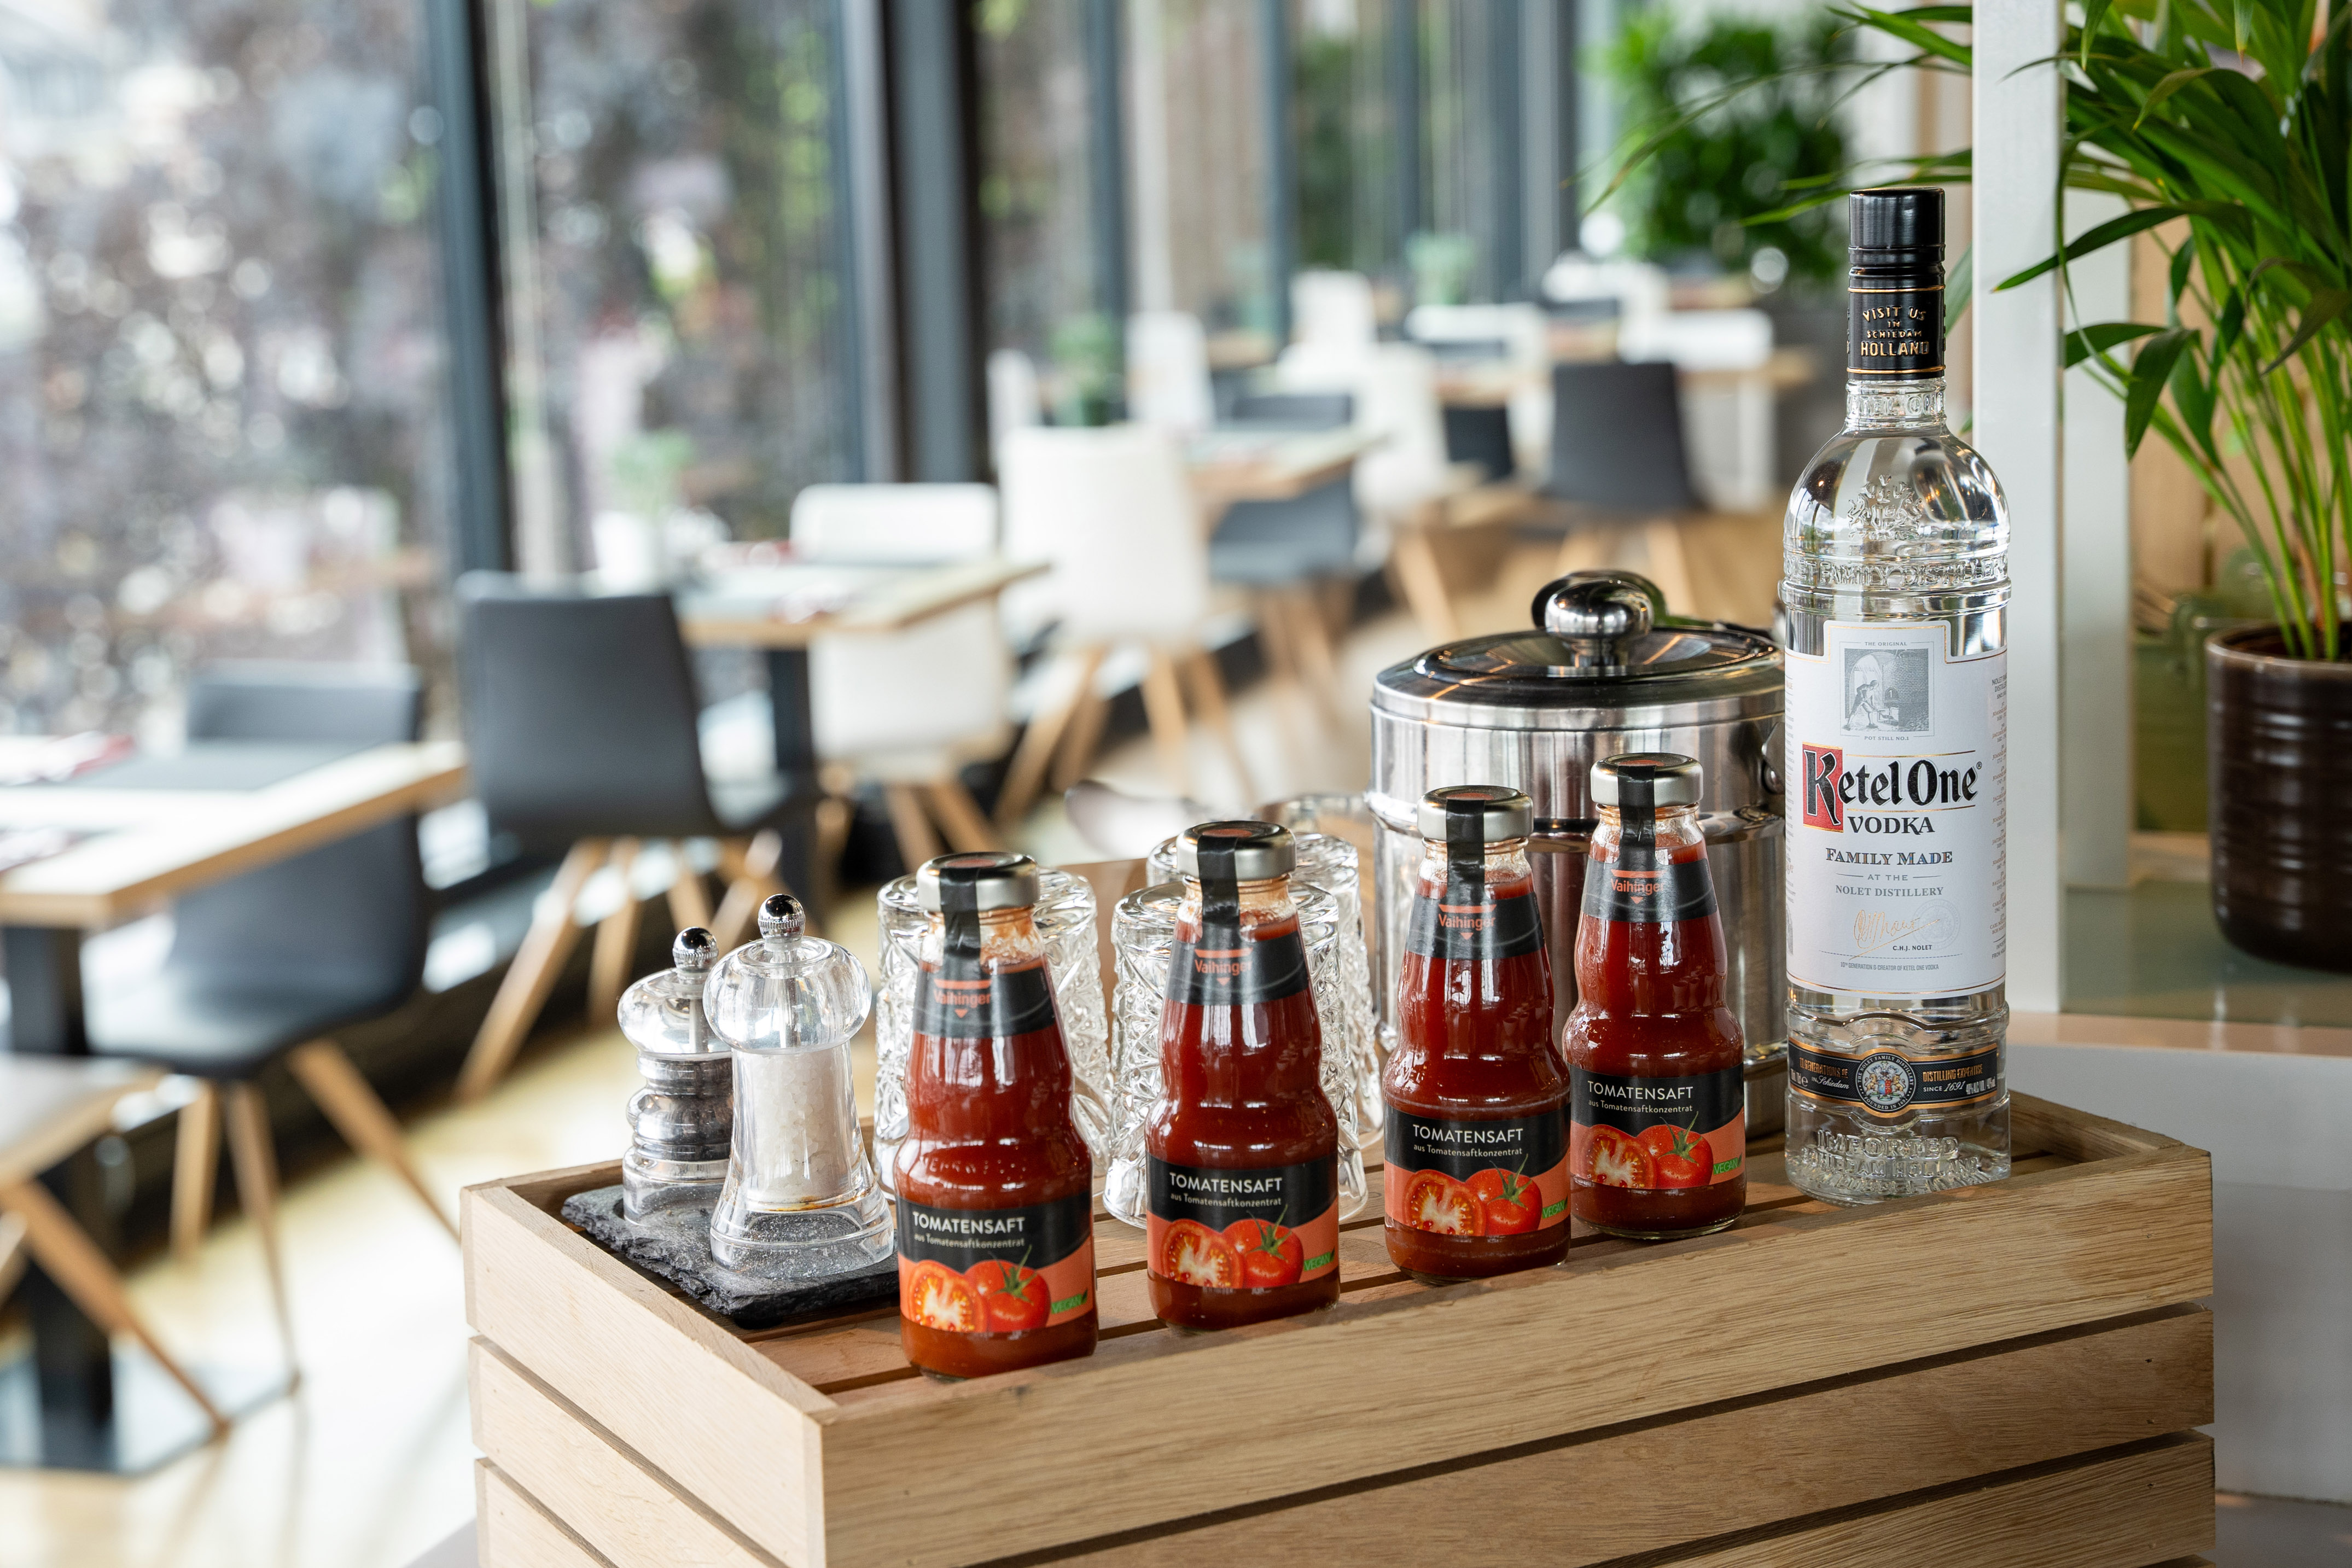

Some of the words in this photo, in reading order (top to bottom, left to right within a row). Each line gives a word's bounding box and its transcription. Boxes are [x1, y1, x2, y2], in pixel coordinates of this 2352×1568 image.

[1862, 306, 1902, 322] VISIT
[1909, 306, 1926, 320] US
[1867, 329, 1922, 338] SCHIEDAM
[1861, 341, 1929, 356] HOLLAND
[1803, 749, 1905, 826] Ketel
[1847, 815, 1935, 835] VODKA
[1826, 848, 1893, 865] FAMILY
[1897, 852, 1952, 865] MADE
[1610, 879, 1664, 895] Vaihinger
[1836, 885, 1871, 896] NOLET
[1874, 887, 1943, 897] DISTILLERY
[1438, 914, 1496, 930] Vaihinger
[1195, 959, 1253, 976] Vaihinger
[934, 989, 991, 1008] Vaihinger
[1804, 1060, 1841, 1077] GENERATIONS
[1860, 1058, 1873, 1072] NOLET
[1896, 1059, 1913, 1085] DISTILLERY
[1923, 1069, 1956, 1082] DISTILLING
[1957, 1064, 1982, 1079] EXPERTISE
[1817, 1075, 1849, 1089] Schiedam
[1943, 1081, 1965, 1092] 1691
[1587, 1081, 1693, 1100] TOMATENSAFT
[1600, 1100, 1693, 1113] Tomatensaftkonzentrat
[1864, 1097, 1888, 1109] FOUNDED
[1413, 1124, 1523, 1143] TOMATENSAFT
[1413, 1144, 1425, 1152] aus
[1427, 1144, 1523, 1157] Tomatensaftkonzentrat
[1714, 1159, 1738, 1174] VEGAN
[1169, 1172, 1282, 1193] TOMATENSAFT
[1171, 1193, 1181, 1202] aus
[1184, 1193, 1282, 1207] Tomatensaftkonzentrat
[1542, 1202, 1565, 1219] VEGAN
[912, 1211, 1025, 1234] TOMATENSAFT
[914, 1234, 924, 1243] aus
[925, 1233, 1024, 1249] Tomatensaftkonzentrat
